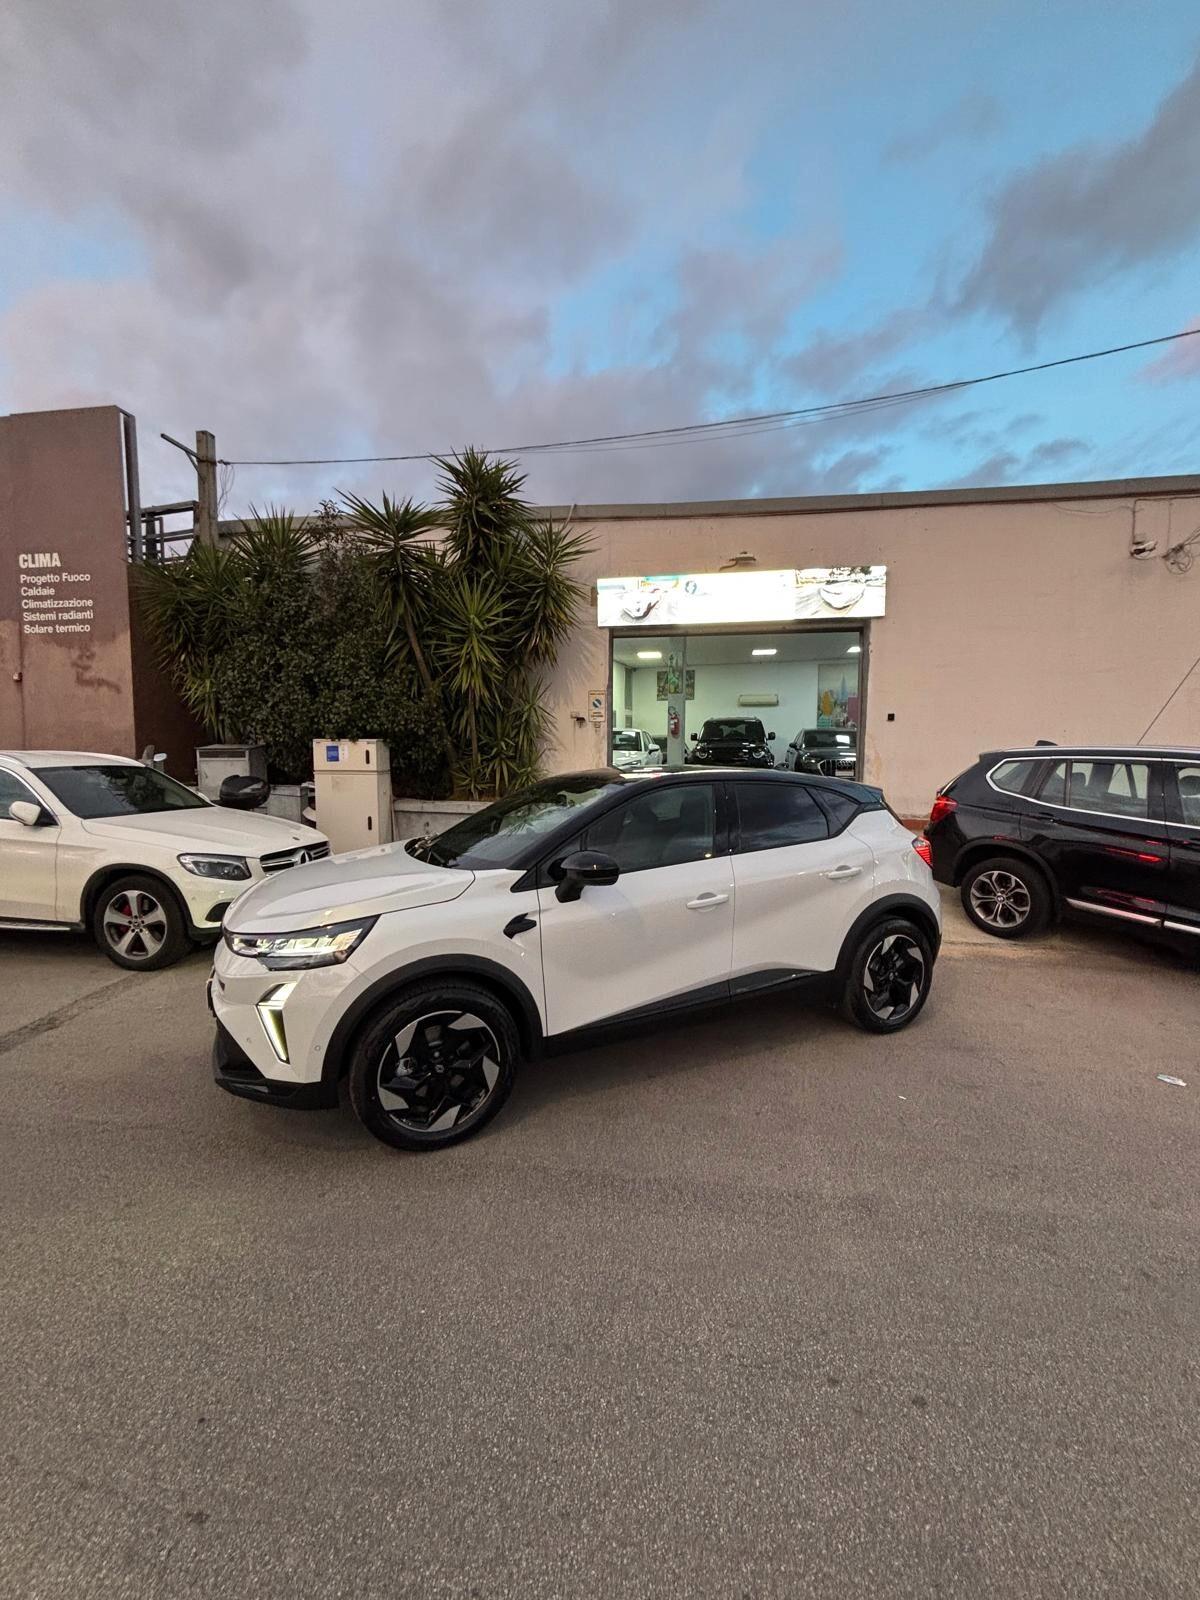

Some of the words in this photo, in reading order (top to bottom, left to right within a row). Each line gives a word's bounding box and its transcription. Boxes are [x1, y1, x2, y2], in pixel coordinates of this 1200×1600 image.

[19, 553, 61, 568] CLIMA
[20, 574, 60, 585] Progetto
[62, 573, 91, 582] Fuoco
[21, 586, 55, 596] Caldaie
[22, 598, 93, 609] Climatizzazione
[23, 611, 56, 621] Sistemi
[58, 610, 93, 620] radianti
[24, 624, 53, 634] Solare
[56, 623, 91, 633] termico
